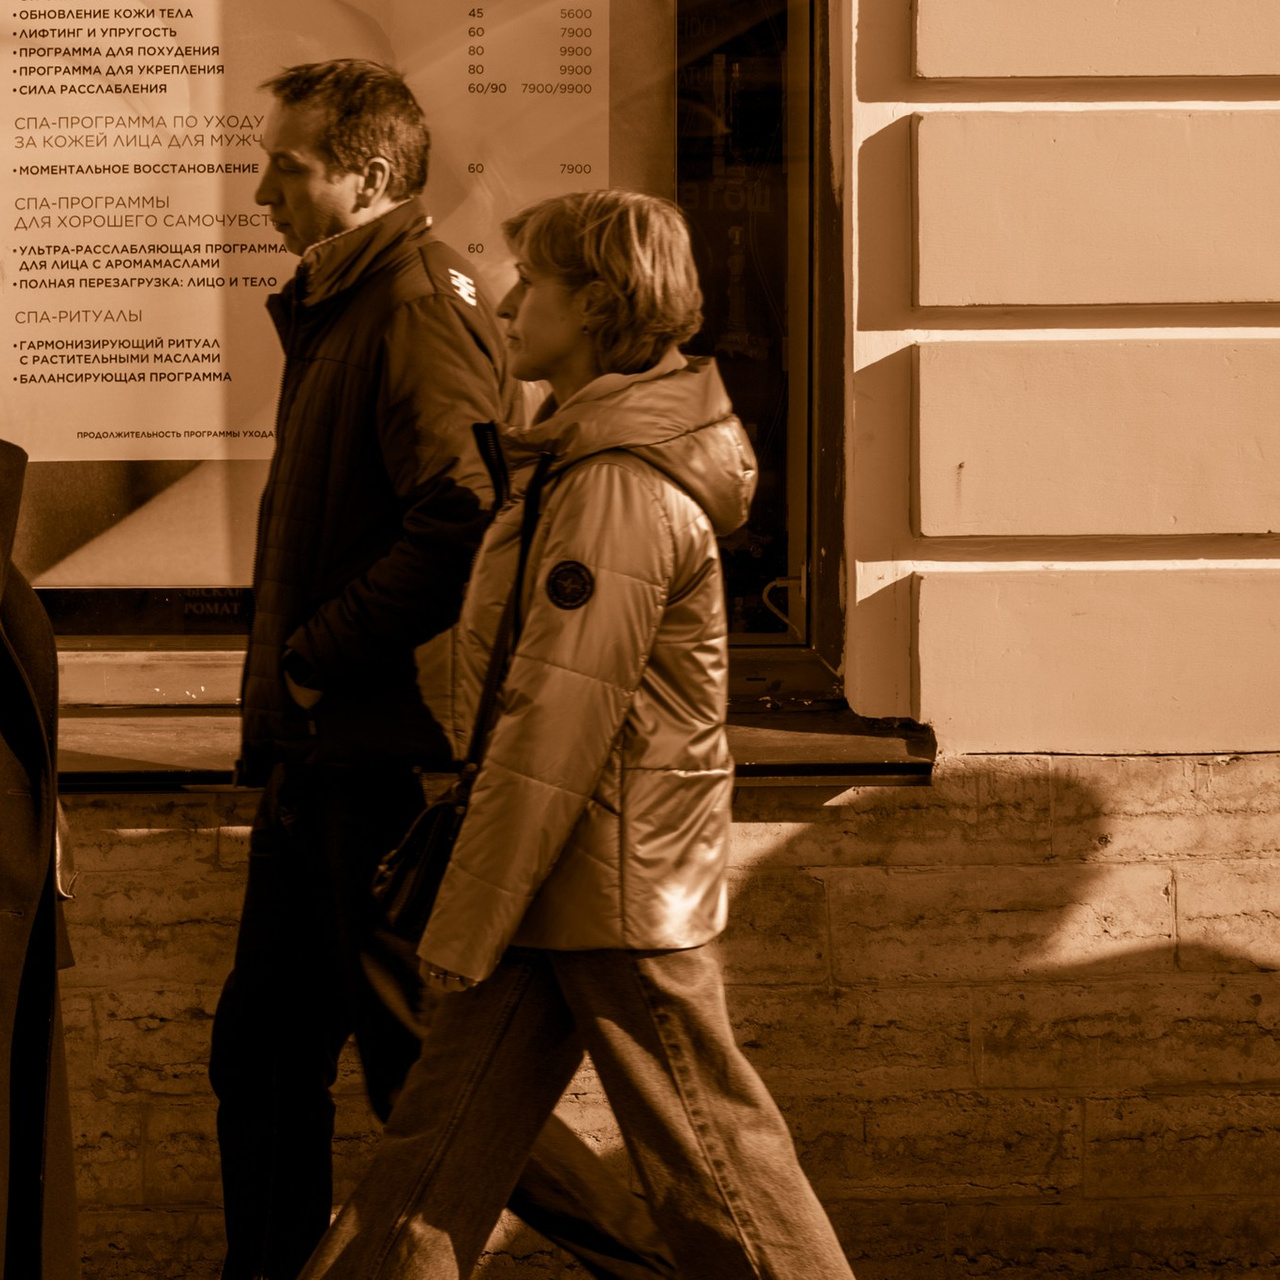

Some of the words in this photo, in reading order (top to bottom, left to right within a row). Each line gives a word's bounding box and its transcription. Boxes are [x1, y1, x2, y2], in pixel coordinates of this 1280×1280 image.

[18, 8, 111, 21] ОБНОВЛЕНИЕ
[113, 8, 156, 20] КОЖИ
[158, 7, 194, 20] ТЕЛА
[467, 7, 484, 19] 45
[559, 8, 593, 20] 5600
[18, 27, 84, 40] ЛИФТИНГ
[86, 27, 97, 39] И
[99, 26, 178, 39] УПРУГОСТЬ
[467, 26, 485, 38] 60
[560, 27, 593, 39] 7900
[19, 46, 103, 59] ПРОГРАММА
[104, 45, 134, 59] ДЛЯ
[137, 45, 220, 59] ПОХУДЕНИЯ
[467, 45, 485, 57] 80
[559, 45, 593, 57] 9900
[18, 64, 103, 78] ПРОГРАММА
[104, 63, 134, 78] ДЛЯ
[136, 63, 226, 77] УКРЕПЛЕНИЯ
[467, 63, 485, 76] 80
[559, 64, 593, 76] 9900
[17, 84, 57, 96] СИЛА
[59, 83, 168, 95] РАССЛАБЛЕНИЯ
[467, 81, 508, 96] 60/90
[520, 82, 593, 96] 7900/9900
[13, 115, 168, 131] СПА-ПРОГРАММА
[173, 114, 199, 129] ПО
[202, 114, 265, 131] УХОДУ
[14, 135, 38, 150] ЗА
[42, 131, 108, 149] КОЖЕЙ
[112, 133, 163, 150] ЛИЦА
[167, 133, 205, 150] ДЛЯ
[210, 133, 263, 148] МУЖЧ
[19, 163, 131, 176] МОМЕНТАЛЬНОЕ
[133, 162, 260, 175] ВОССТАНОВЛЕНИЕ
[467, 162, 485, 174] 60
[559, 163, 592, 175] 7900
[14, 195, 170, 211] СПА-ПРОГРАММЫ
[13, 215, 52, 232] ДЛЯ
[56, 213, 158, 229] ХОРОШЕГО
[162, 213, 273, 228] САМОЧУВСТ
[18, 243, 202, 257] УЛЬТРА-РАССЛАБЛЯЮЩАЯ
[204, 242, 288, 255] ПРОГРАММА
[467, 242, 485, 254] 60
[18, 259, 48, 272] ДЛЯ
[50, 258, 90, 272] ЛИЦА
[91, 258, 102, 270] С
[104, 257, 220, 270] АРОМАМАСЛАМИ
[19, 277, 76, 290] ПОЛНАЯ
[78, 276, 184, 289] ПЕРЕЗАГРУЗКА:
[186, 276, 226, 290] ЛИЦО
[228, 276, 239, 288] И
[241, 276, 278, 288] ТЕЛО
[14, 309, 143, 325] СПА-РИТУАЛЫ
[19, 335, 164, 352] ГАРМОНИЗИРУЮЩИЙ
[167, 337, 221, 350] РИТУАЛ
[18, 354, 29, 366] С
[31, 352, 150, 366] РАСТИТЕЛЬНЫМИ
[152, 352, 221, 364] МАСЛАМИ
[19, 371, 146, 385] БАЛАНСИРУЮЩАЯ
[149, 371, 233, 383] ПРОГРАММА
[76, 430, 182, 441] ПРОДОЛЖИТЕЛЬНОСТЬ
[183, 430, 241, 439] ПРОГРАММЫ
[242, 430, 275, 439] УХОДА
